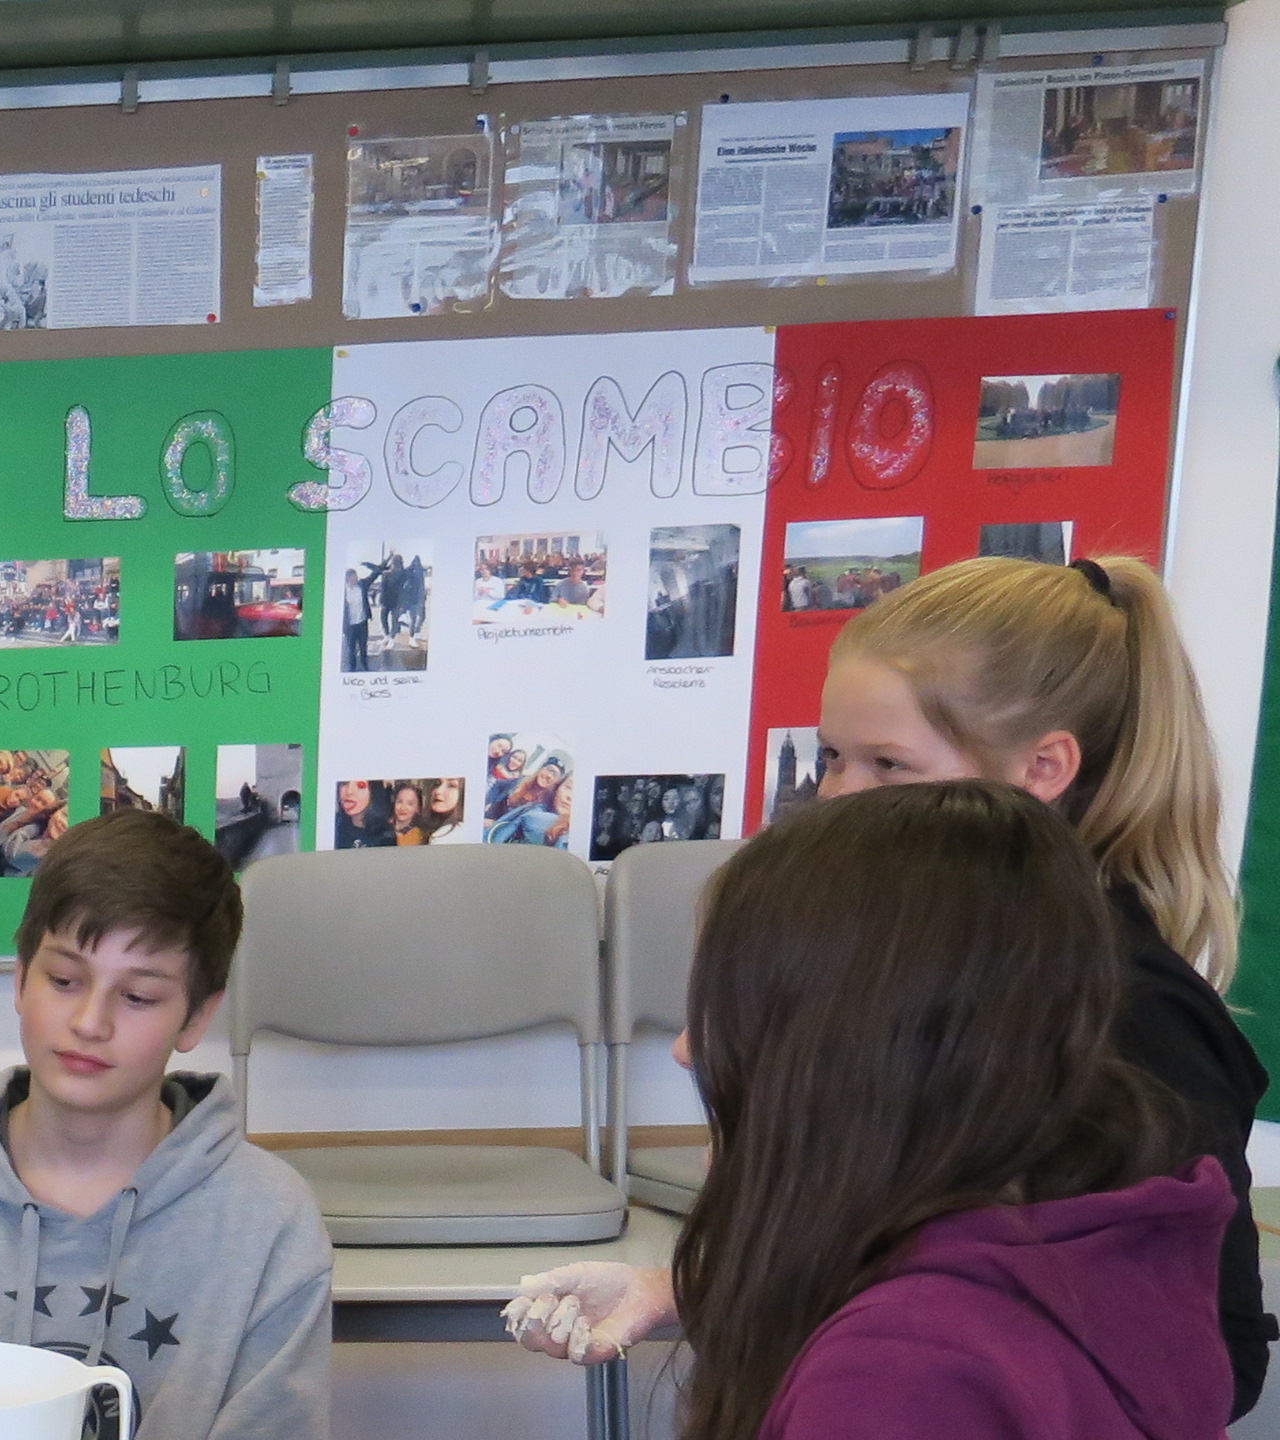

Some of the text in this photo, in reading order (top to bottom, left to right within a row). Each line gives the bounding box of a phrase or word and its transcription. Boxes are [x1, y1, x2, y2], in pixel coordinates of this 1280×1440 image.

[717, 146, 735, 156] Eine
[788, 143, 817, 153] Woche
[39, 190, 57, 212] gli
[60, 188, 115, 206] studenti
[119, 185, 175, 204] tedeschi
[63, 357, 936, 523] LO SCAMBIO
[369, 675, 389, 686] und
